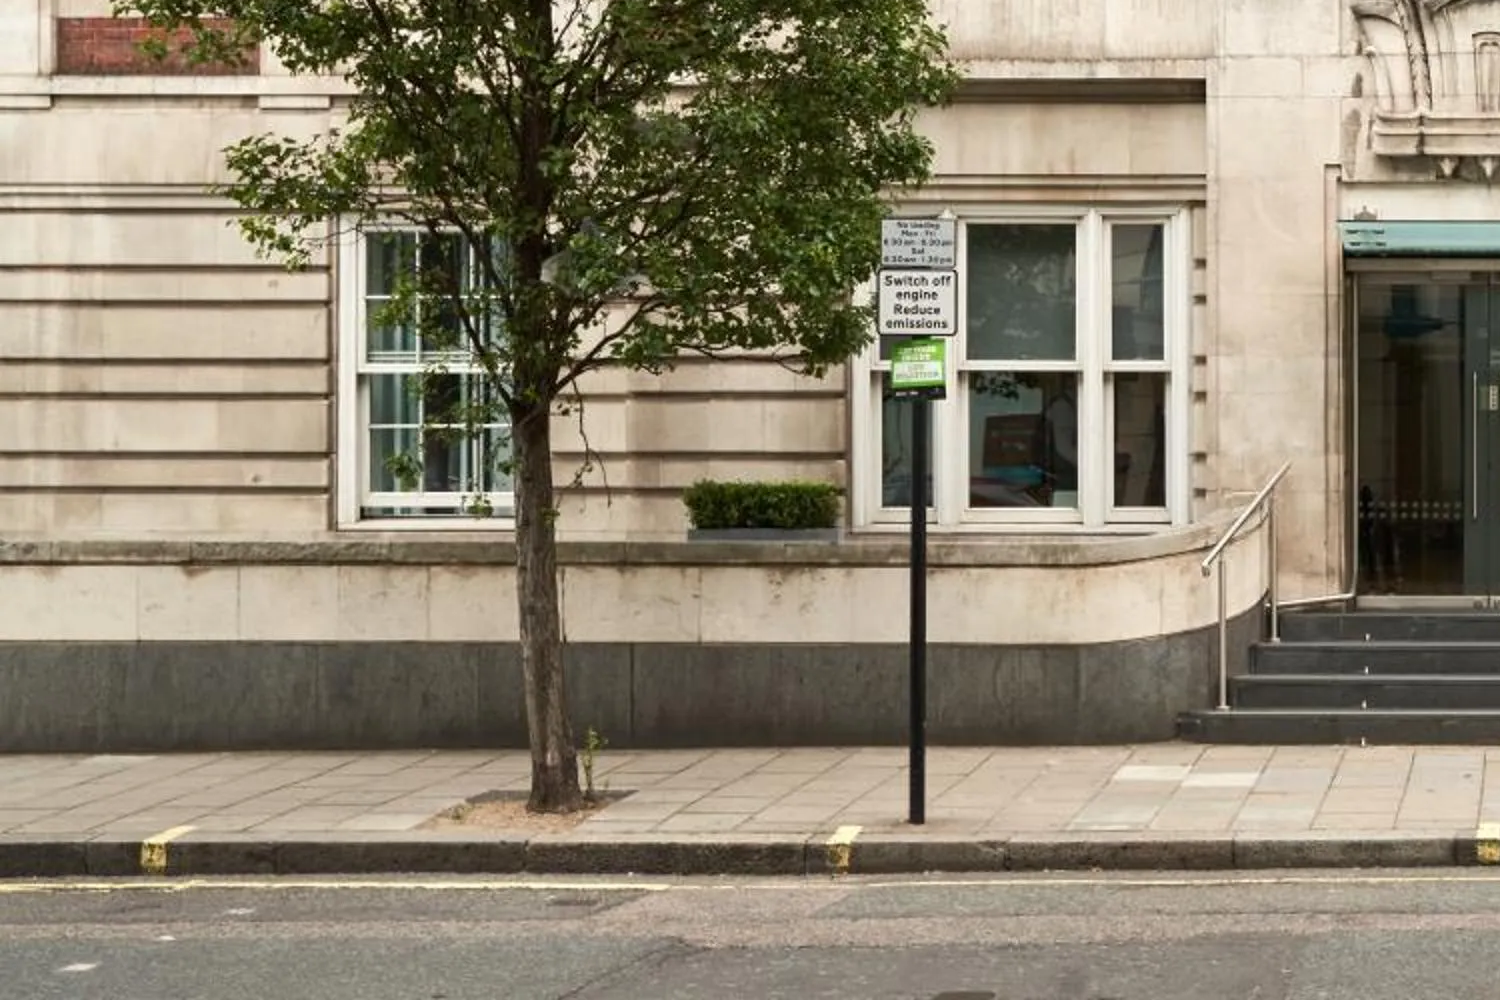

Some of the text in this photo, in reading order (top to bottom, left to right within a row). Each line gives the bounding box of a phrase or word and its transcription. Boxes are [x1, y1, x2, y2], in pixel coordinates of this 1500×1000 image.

[884, 275, 952, 287] Switch off
[895, 289, 939, 302] engine
[893, 303, 941, 315] Reduce
[885, 317, 949, 329] emissions
